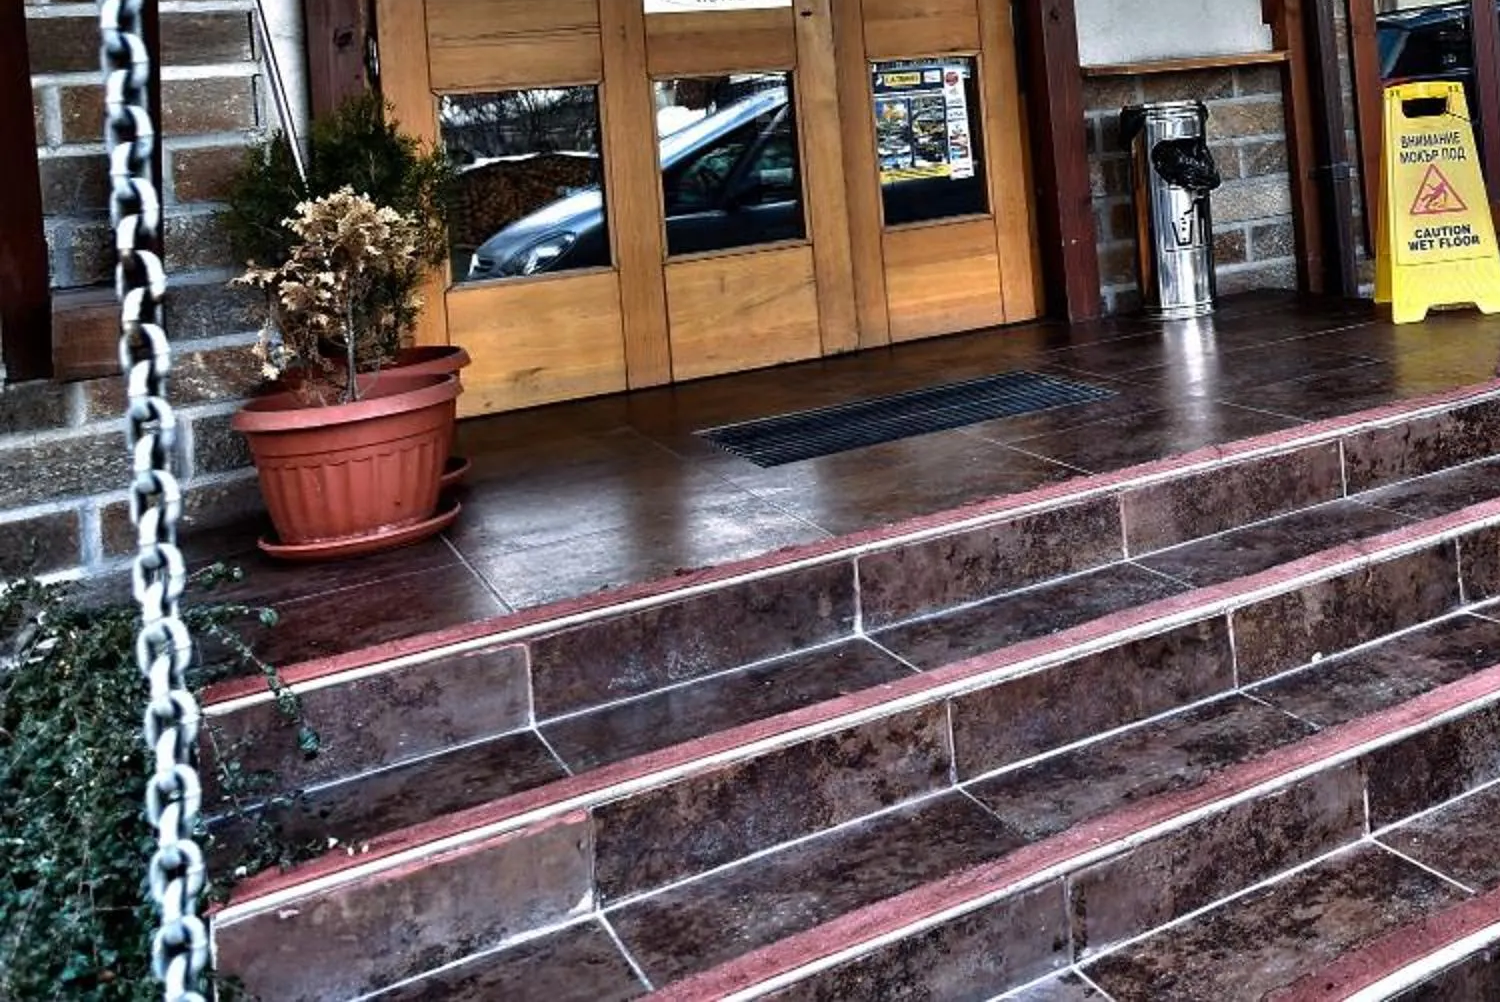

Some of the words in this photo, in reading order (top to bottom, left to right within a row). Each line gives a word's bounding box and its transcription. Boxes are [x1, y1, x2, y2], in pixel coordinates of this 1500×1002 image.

[1401, 132, 1461, 148] ВНИМАНИЕ
[1400, 148, 1439, 164] МОКЪР
[1441, 146, 1467, 161] ПОД
[1414, 224, 1472, 239] CAUTION
[1408, 238, 1435, 251] WET
[1439, 234, 1481, 249] FLOOR
